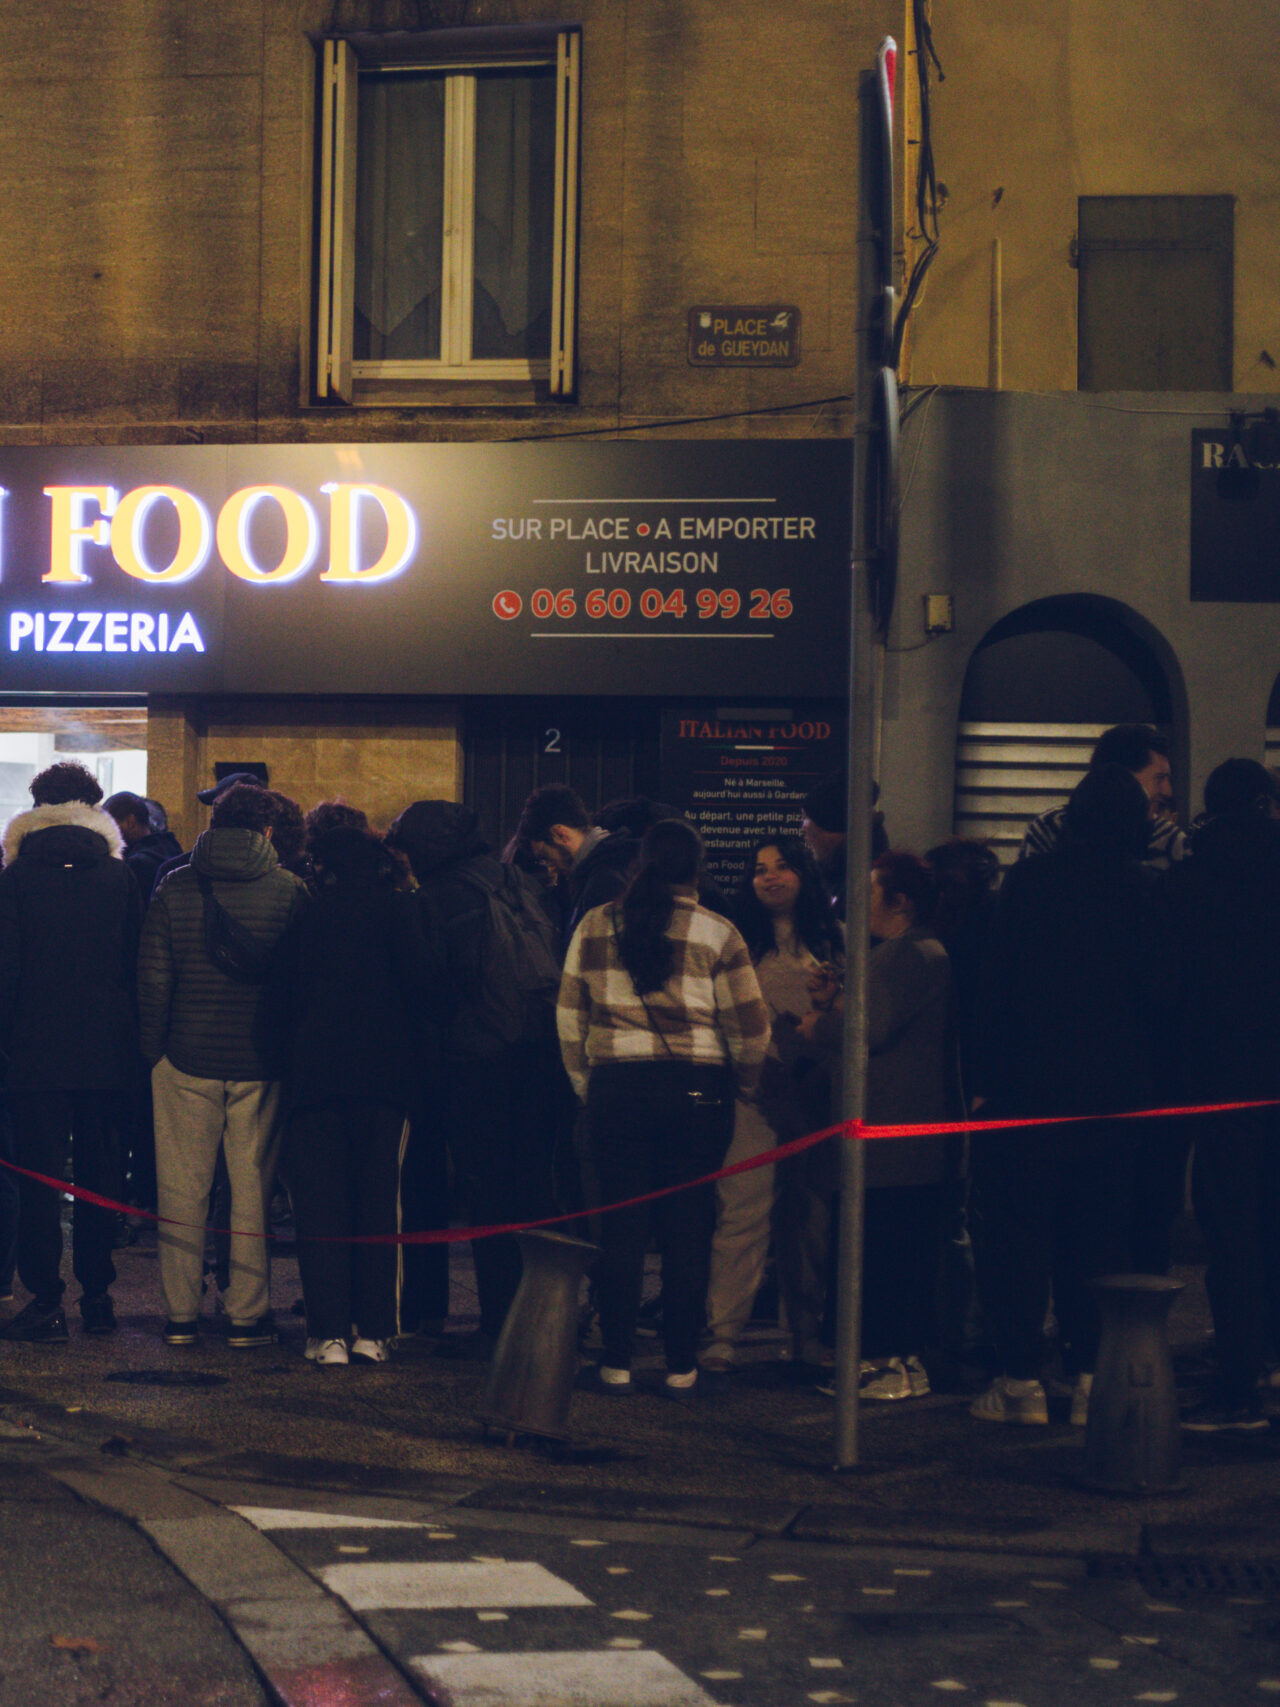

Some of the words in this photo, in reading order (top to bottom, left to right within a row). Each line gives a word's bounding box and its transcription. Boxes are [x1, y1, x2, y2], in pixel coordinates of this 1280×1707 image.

[713, 318, 768, 336] PLACE
[697, 340, 716, 357] de
[721, 340, 789, 357] GUEYDAN
[42, 482, 417, 583] FOOD
[491, 518, 542, 540] SUR
[550, 518, 630, 540] PLACE
[654, 518, 672, 540] A
[680, 517, 816, 540] EMPORTER
[586, 552, 718, 573] LIVRAISON
[531, 588, 577, 618] 06
[585, 588, 632, 618] 60
[640, 588, 687, 618] 04
[696, 588, 741, 618] 99
[749, 588, 794, 618] 26
[10, 612, 205, 652] PIZZERIA
[679, 720, 762, 739] ITALIAN
[768, 721, 831, 740] FOOD
[544, 728, 561, 753] 2
[721, 755, 759, 768] Depuis
[724, 777, 737, 787] Né
[693, 789, 741, 799] aujourd'hui
[743, 790, 765, 799] aussi
[684, 810, 697, 820] Au
[736, 812, 753, 821] une
[757, 810, 784, 822] petite
[700, 824, 740, 835] devenue
[743, 826, 765, 835] avec
[768, 825, 777, 836] le
[779, 826, 804, 838] temp
[704, 839, 751, 849] estaurant
